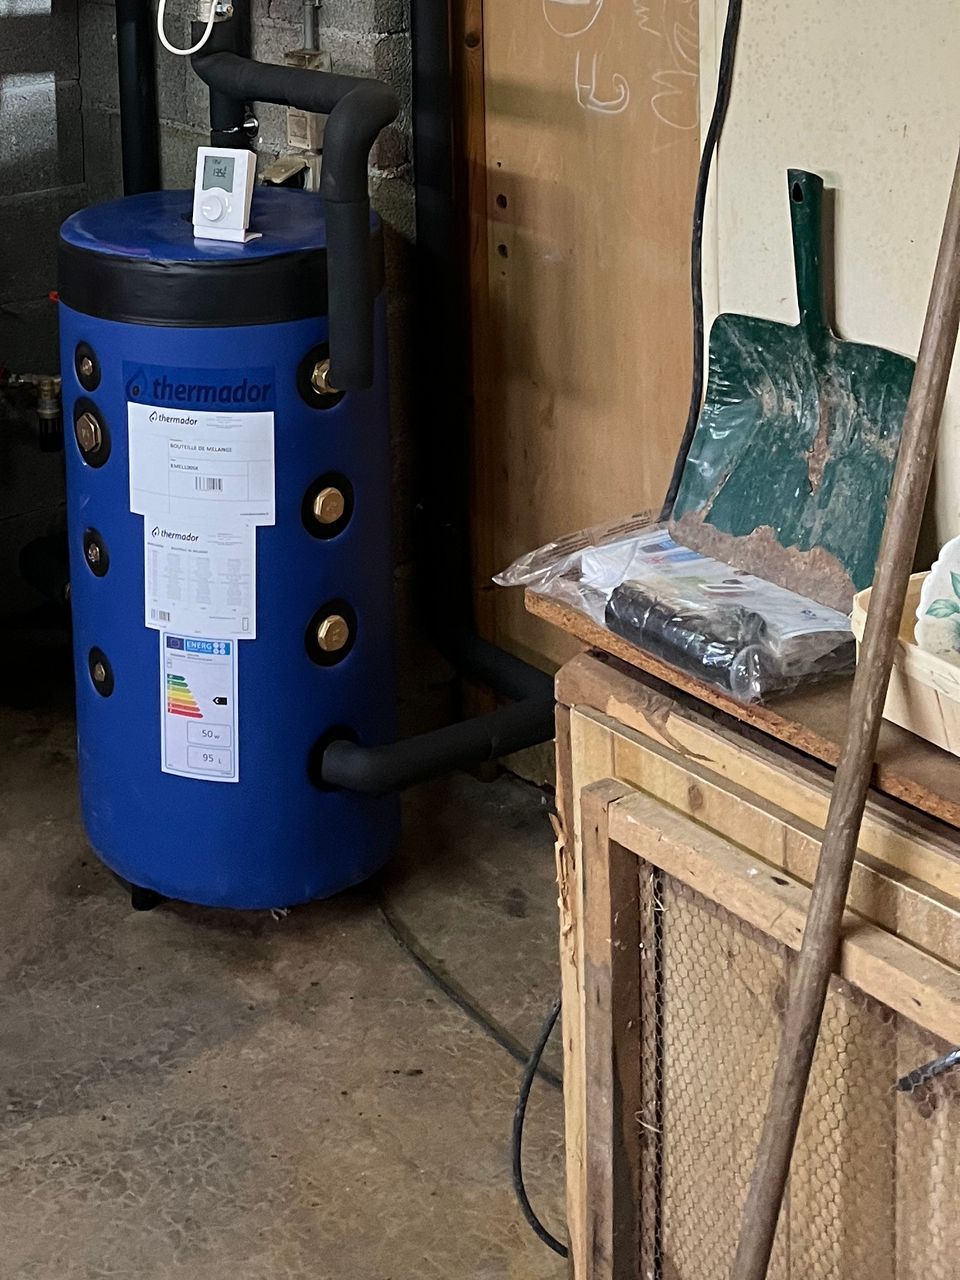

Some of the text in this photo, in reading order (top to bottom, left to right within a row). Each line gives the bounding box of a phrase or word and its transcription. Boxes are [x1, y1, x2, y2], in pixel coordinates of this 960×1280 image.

[152, 375, 271, 404] thermador
[158, 413, 198, 426] thermador
[170, 443, 197, 451] BOUTEILLE
[161, 529, 199, 542] thermador
[186, 640, 212, 650] ENERG
[201, 729, 214, 738] 50
[202, 753, 214, 763] 95
